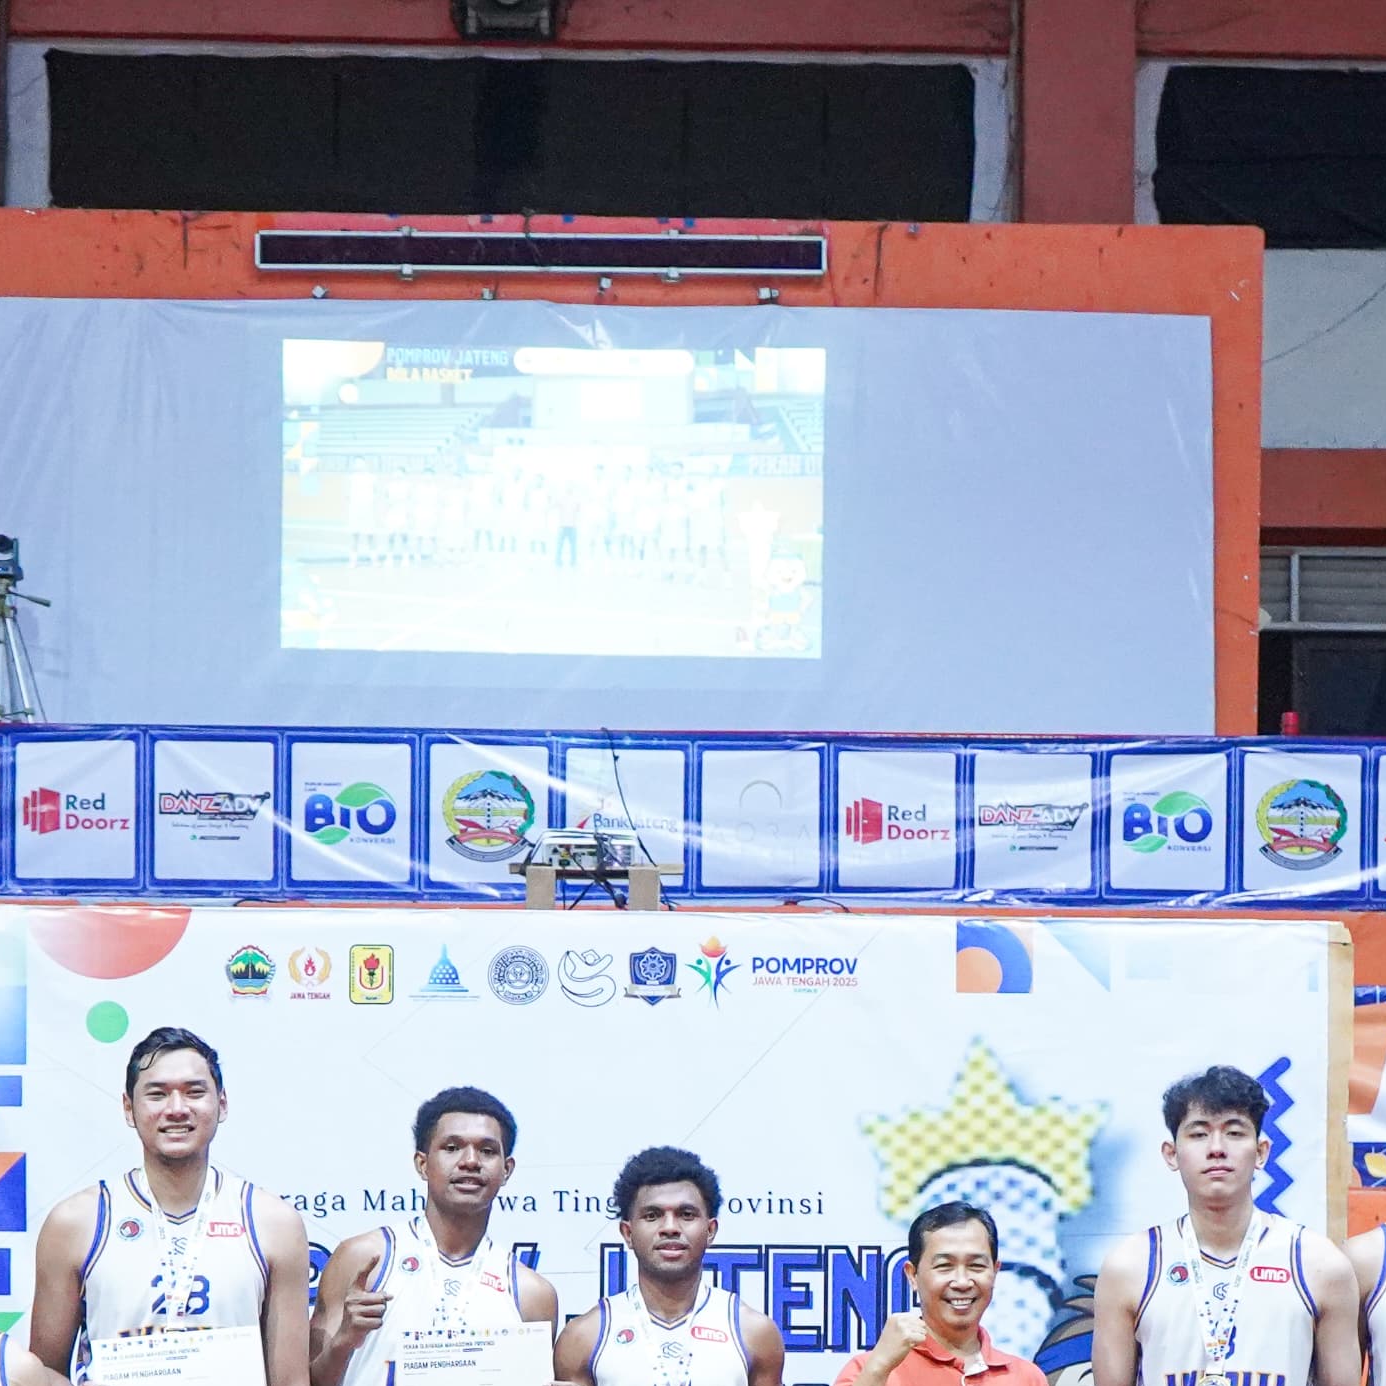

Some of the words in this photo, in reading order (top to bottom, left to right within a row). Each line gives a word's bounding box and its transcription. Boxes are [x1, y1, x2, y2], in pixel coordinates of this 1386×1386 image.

[455, 349, 509, 368] JATENG
[65, 792, 106, 812] Red
[65, 813, 131, 832] Doorz
[304, 793, 397, 836] BIO
[593, 812, 629, 830] Bank
[635, 815, 678, 834] ateng
[888, 804, 928, 823] Red
[1123, 803, 1213, 843] BIO
[349, 837, 397, 845] KONVERSI
[887, 823, 952, 842] Doorz
[751, 956, 859, 975] POMPROV
[752, 976, 782, 987] JAWA
[785, 977, 830, 987] TENGAH
[832, 977, 858, 987] 2025
[289, 992, 306, 1000] JAWA
[307, 992, 331, 1000] TENGAH
[553, 1189, 623, 1218] Ting
[728, 1188, 825, 1215] ovinsi
[1252, 1267, 1288, 1282] LIMA
[694, 1327, 726, 1342] LIMA
[404, 1361, 429, 1370] PIAGAM
[430, 1359, 477, 1369] PENGHARGAAN
